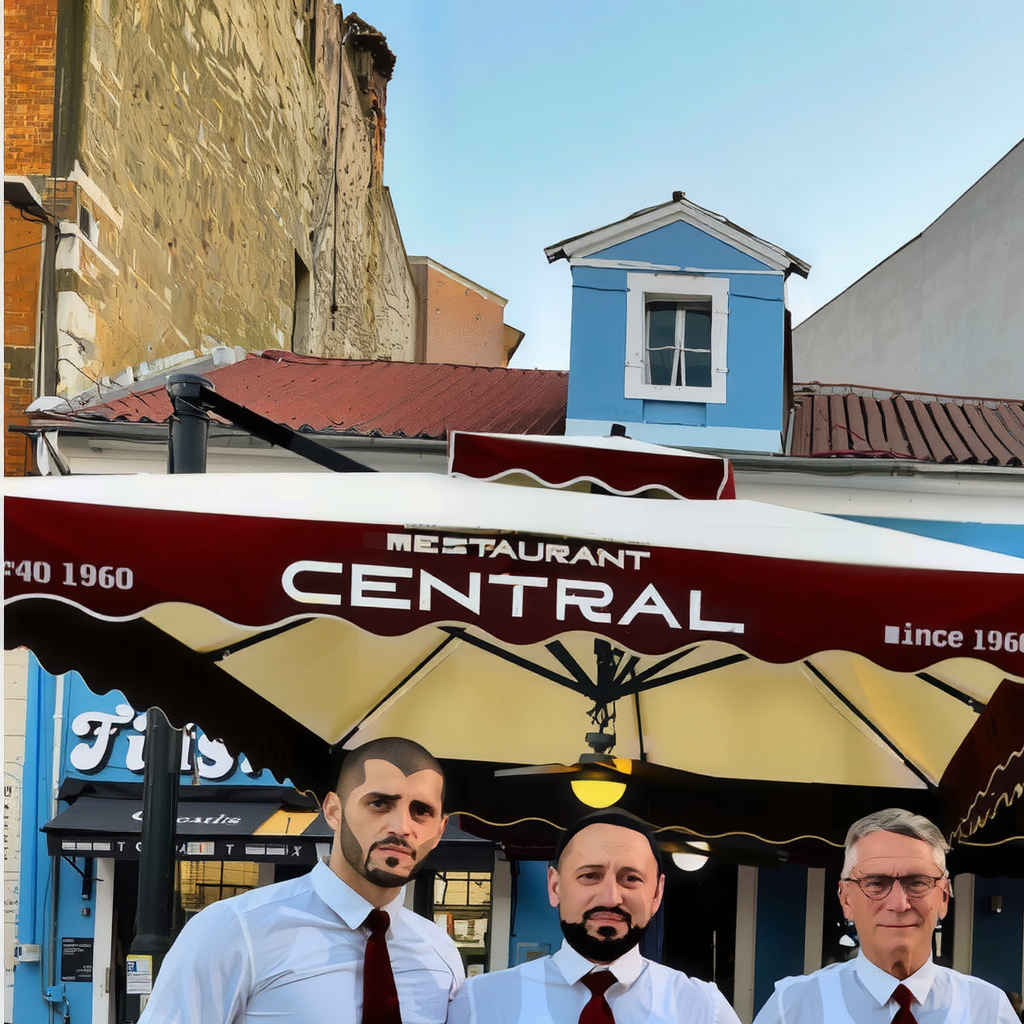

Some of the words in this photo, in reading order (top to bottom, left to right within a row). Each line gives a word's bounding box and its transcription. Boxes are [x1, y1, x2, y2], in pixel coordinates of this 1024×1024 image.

[62, 562, 134, 590] 1960
[281, 560, 745, 634] CENTRAL
[884, 622, 964, 648] ince
